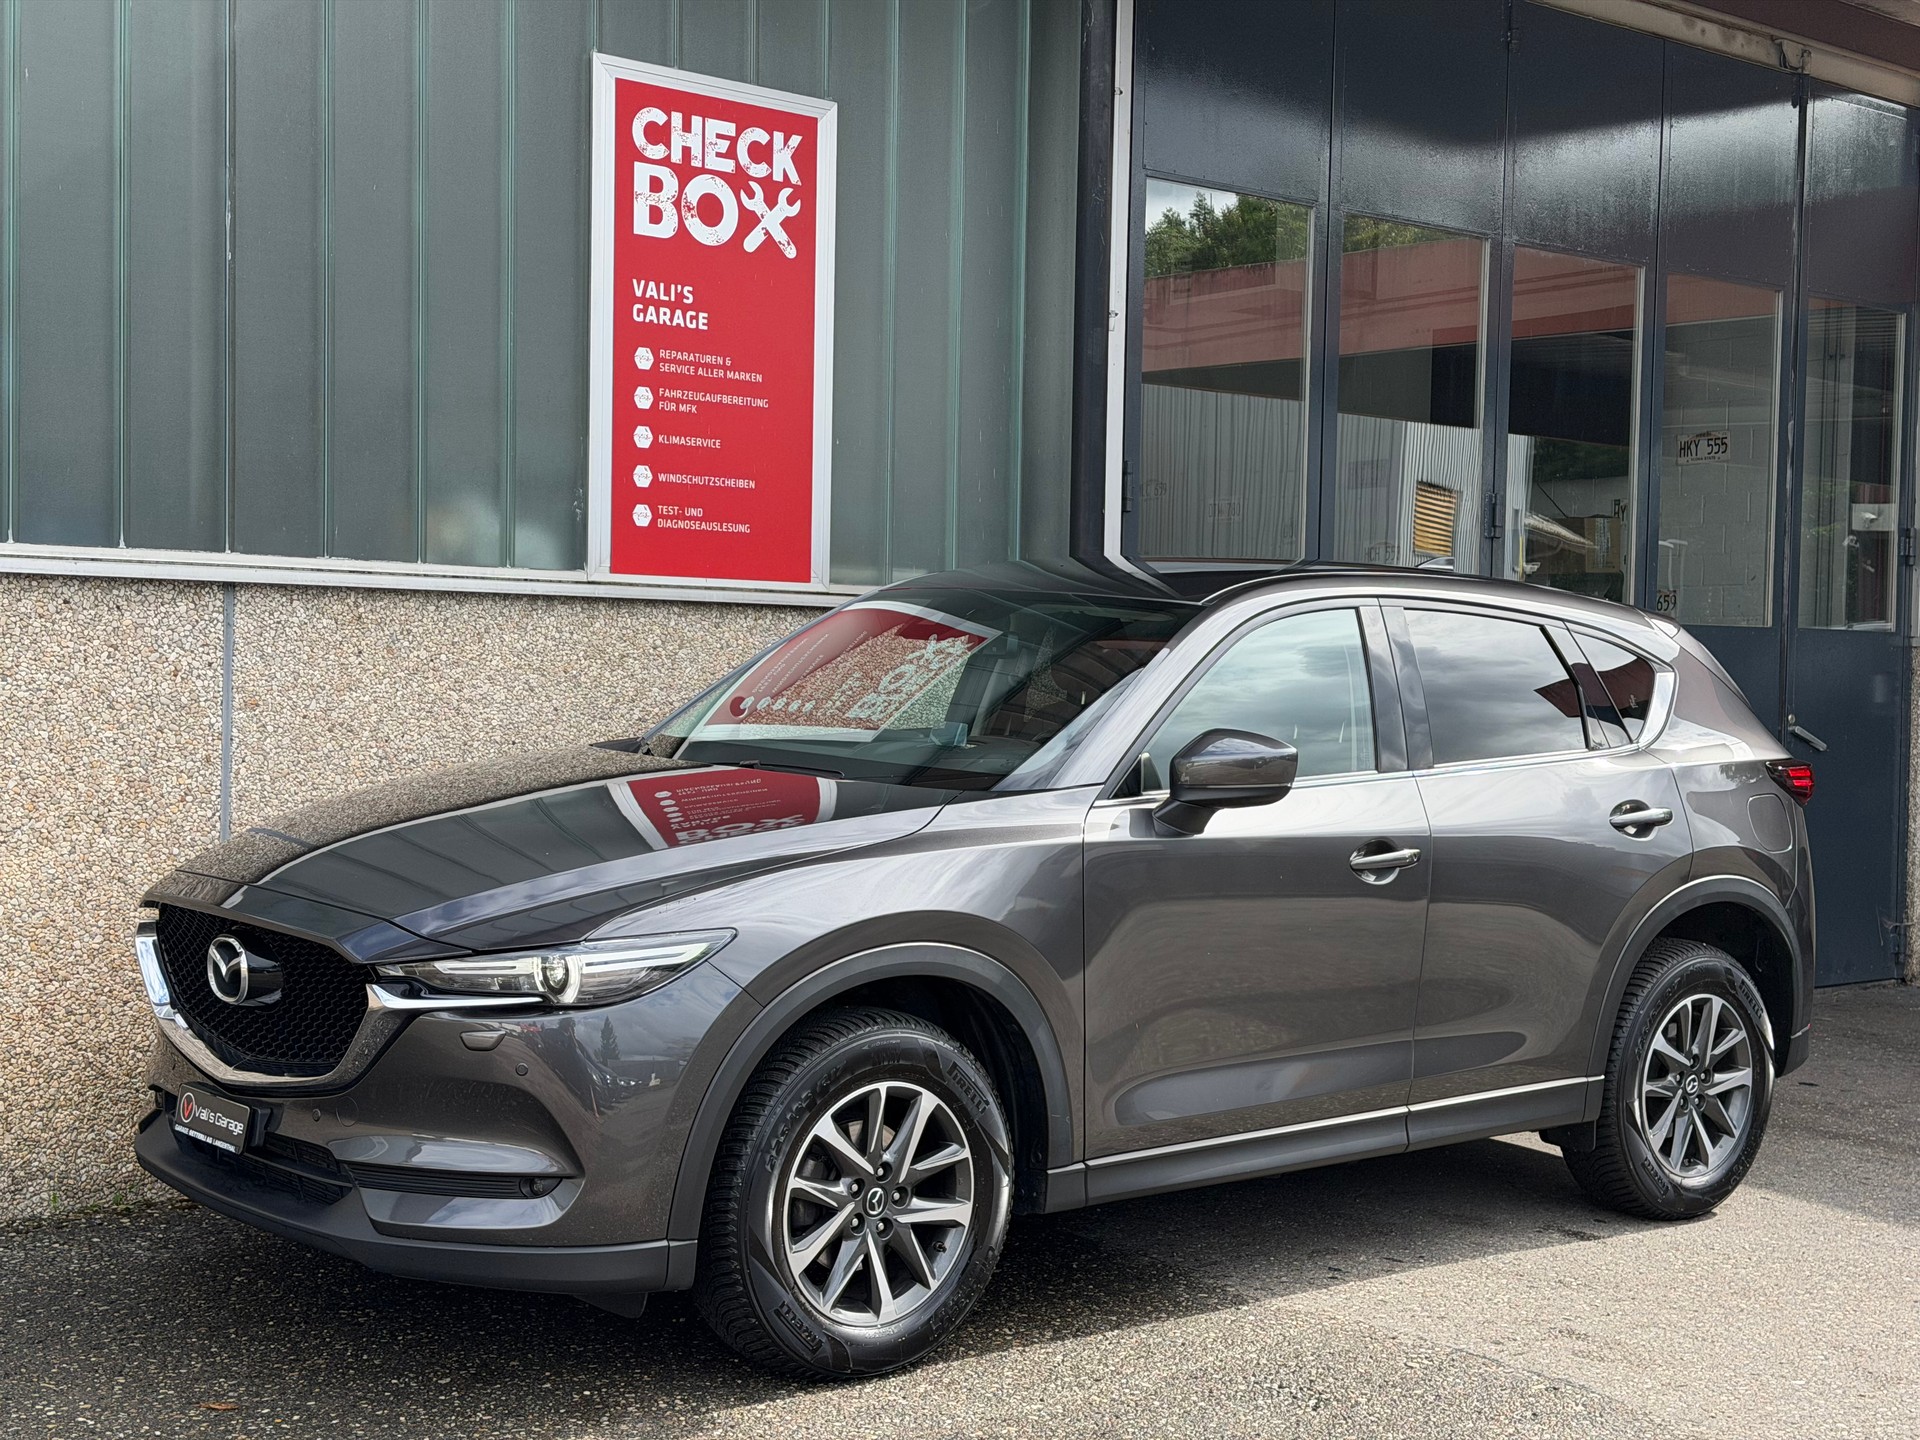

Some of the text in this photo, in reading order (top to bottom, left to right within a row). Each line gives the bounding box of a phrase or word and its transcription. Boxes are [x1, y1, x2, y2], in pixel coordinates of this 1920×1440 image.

[632, 106, 803, 186] CHECK
[632, 278, 694, 304] VALI'S
[632, 303, 709, 331] GARAGE
[659, 349, 732, 366] REPARATUREN &
[659, 362, 763, 383] SERVICE ALLER MARKEN
[658, 400, 698, 414] FÜR MFK
[659, 388, 769, 409] FAHRZEUGAUFBEREITUNG
[658, 434, 721, 449] KLIMASERVICE
[1679, 436, 1728, 458] HKY 555
[658, 472, 756, 489] WINDSCHUTZSCHEIBEN
[657, 505, 703, 517] TEST- UND
[657, 520, 750, 534] DIAGNOSEAUSLESUNG
[215, 1113, 244, 1136] Garage
